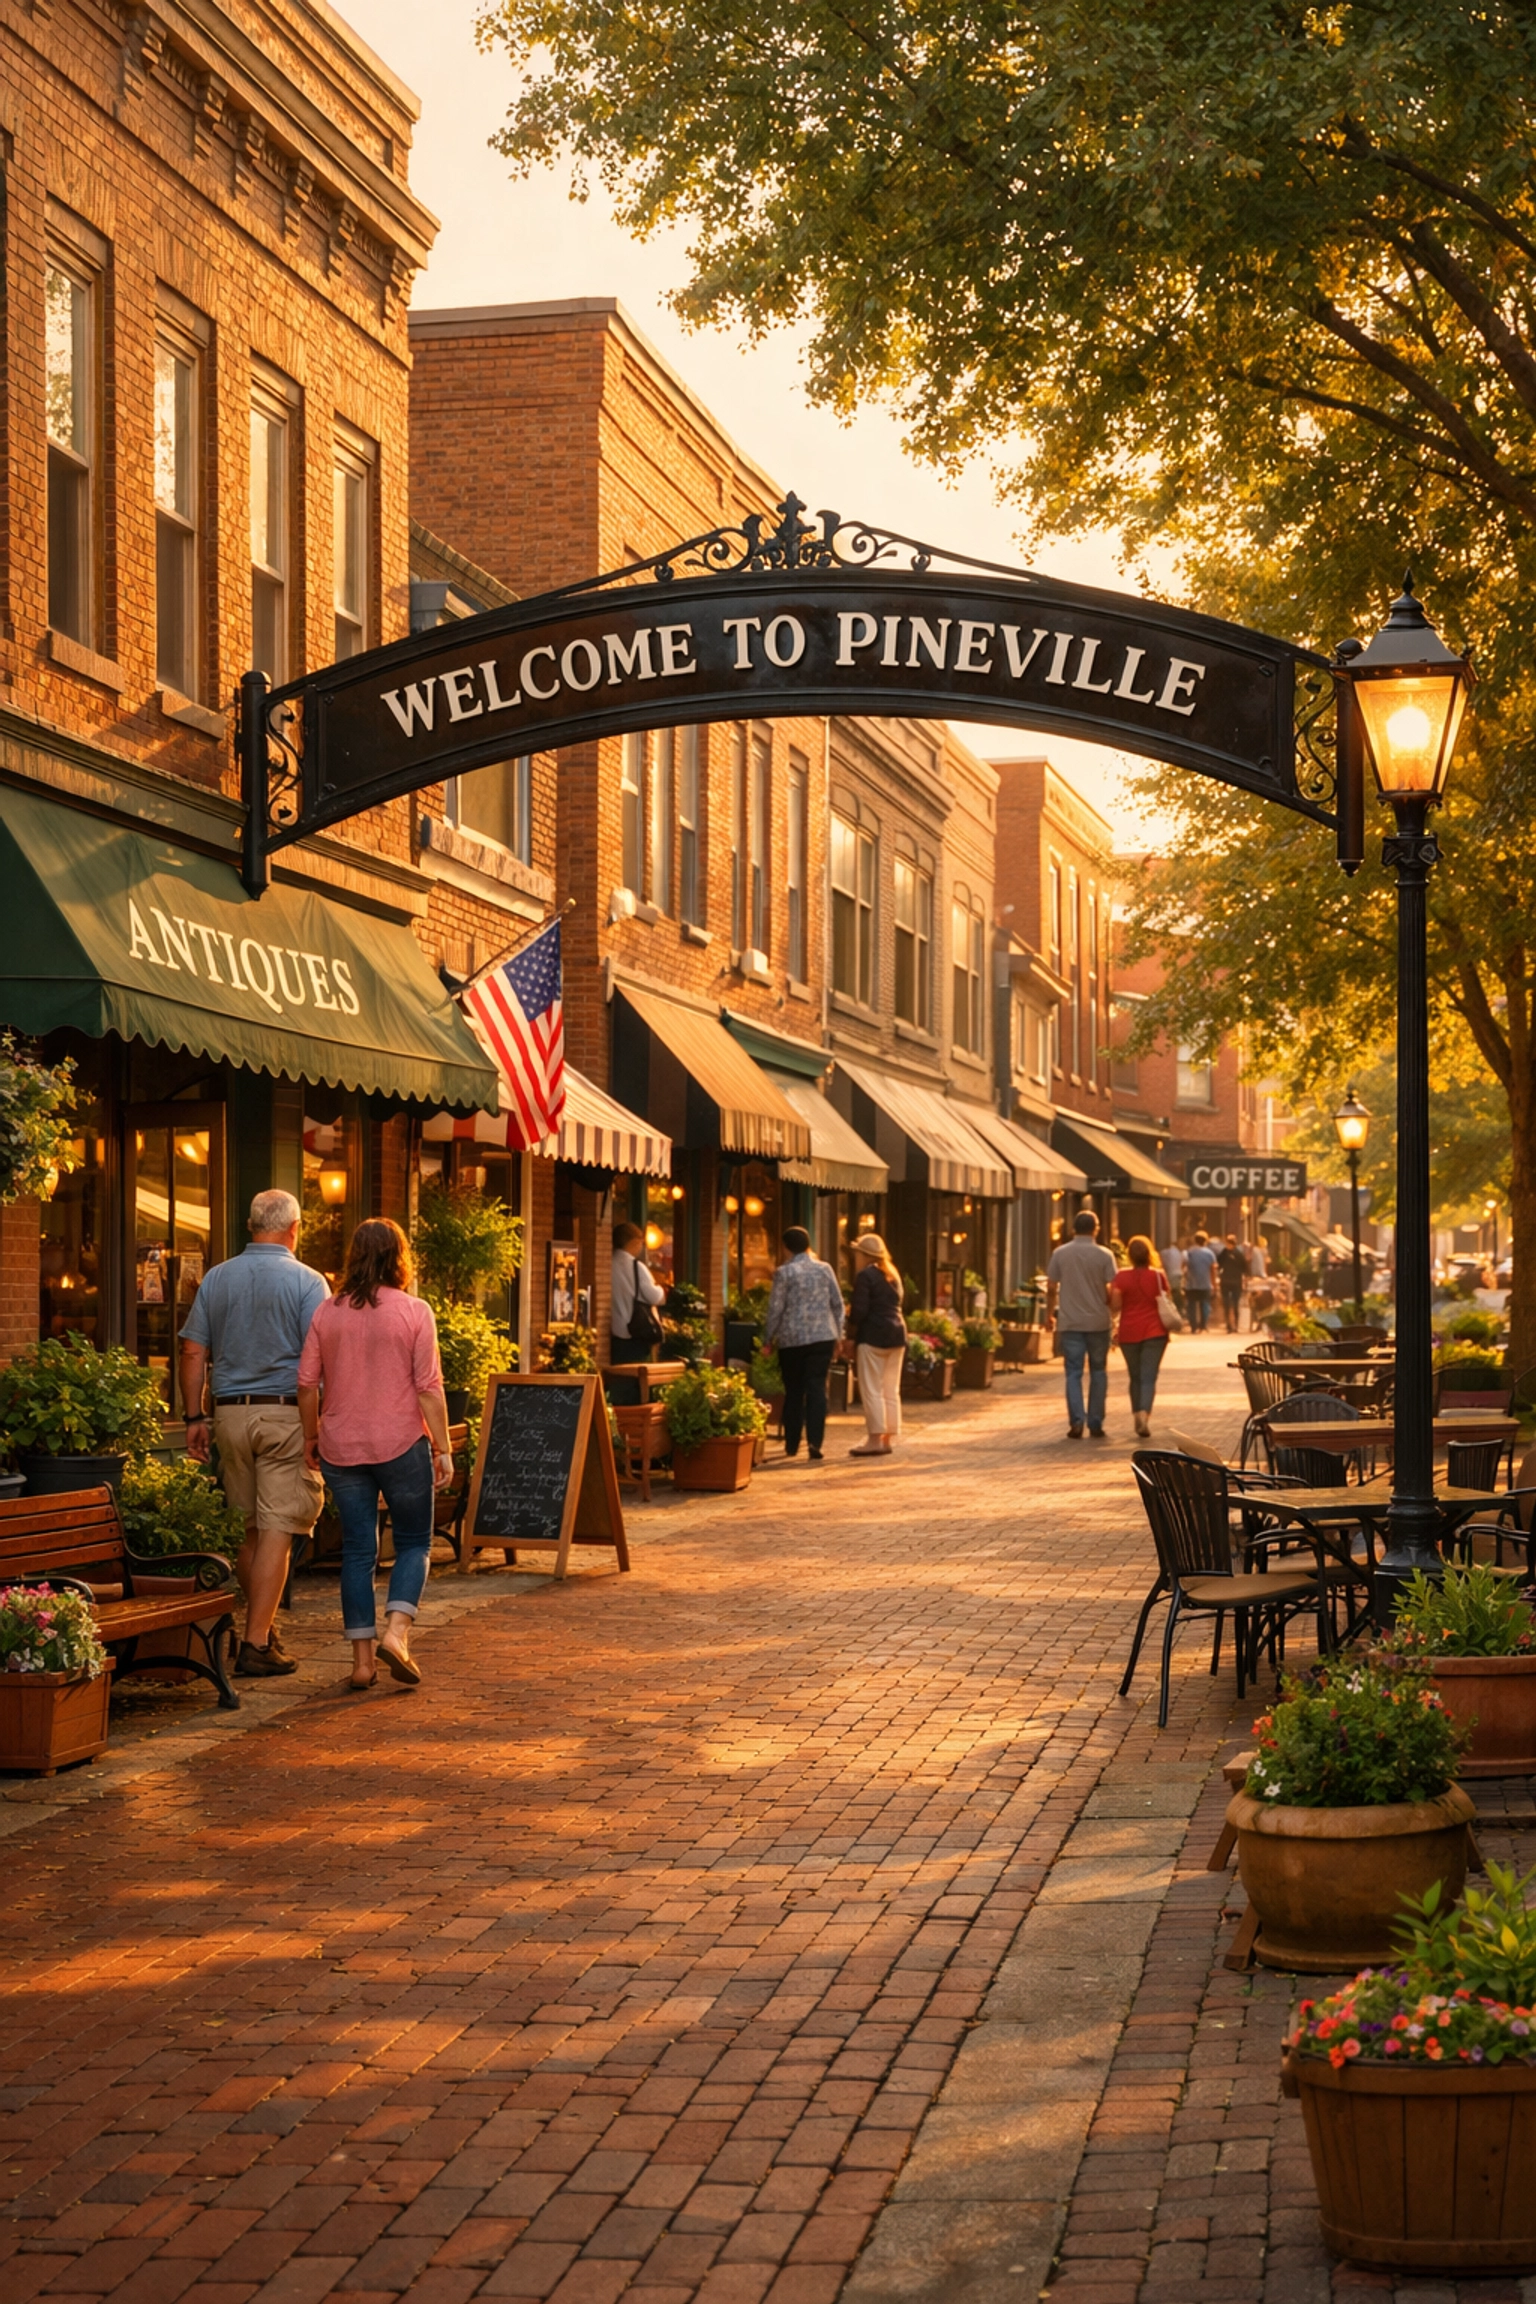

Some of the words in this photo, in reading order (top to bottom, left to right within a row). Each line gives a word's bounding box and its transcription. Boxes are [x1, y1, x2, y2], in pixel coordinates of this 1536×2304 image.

[380, 622, 698, 738] WELCOME
[723, 614, 805, 669] TO
[835, 612, 1207, 716] PINEVILLE
[128, 898, 361, 1016] ANTIQUES
[1192, 1166, 1300, 1191] COFFEE
